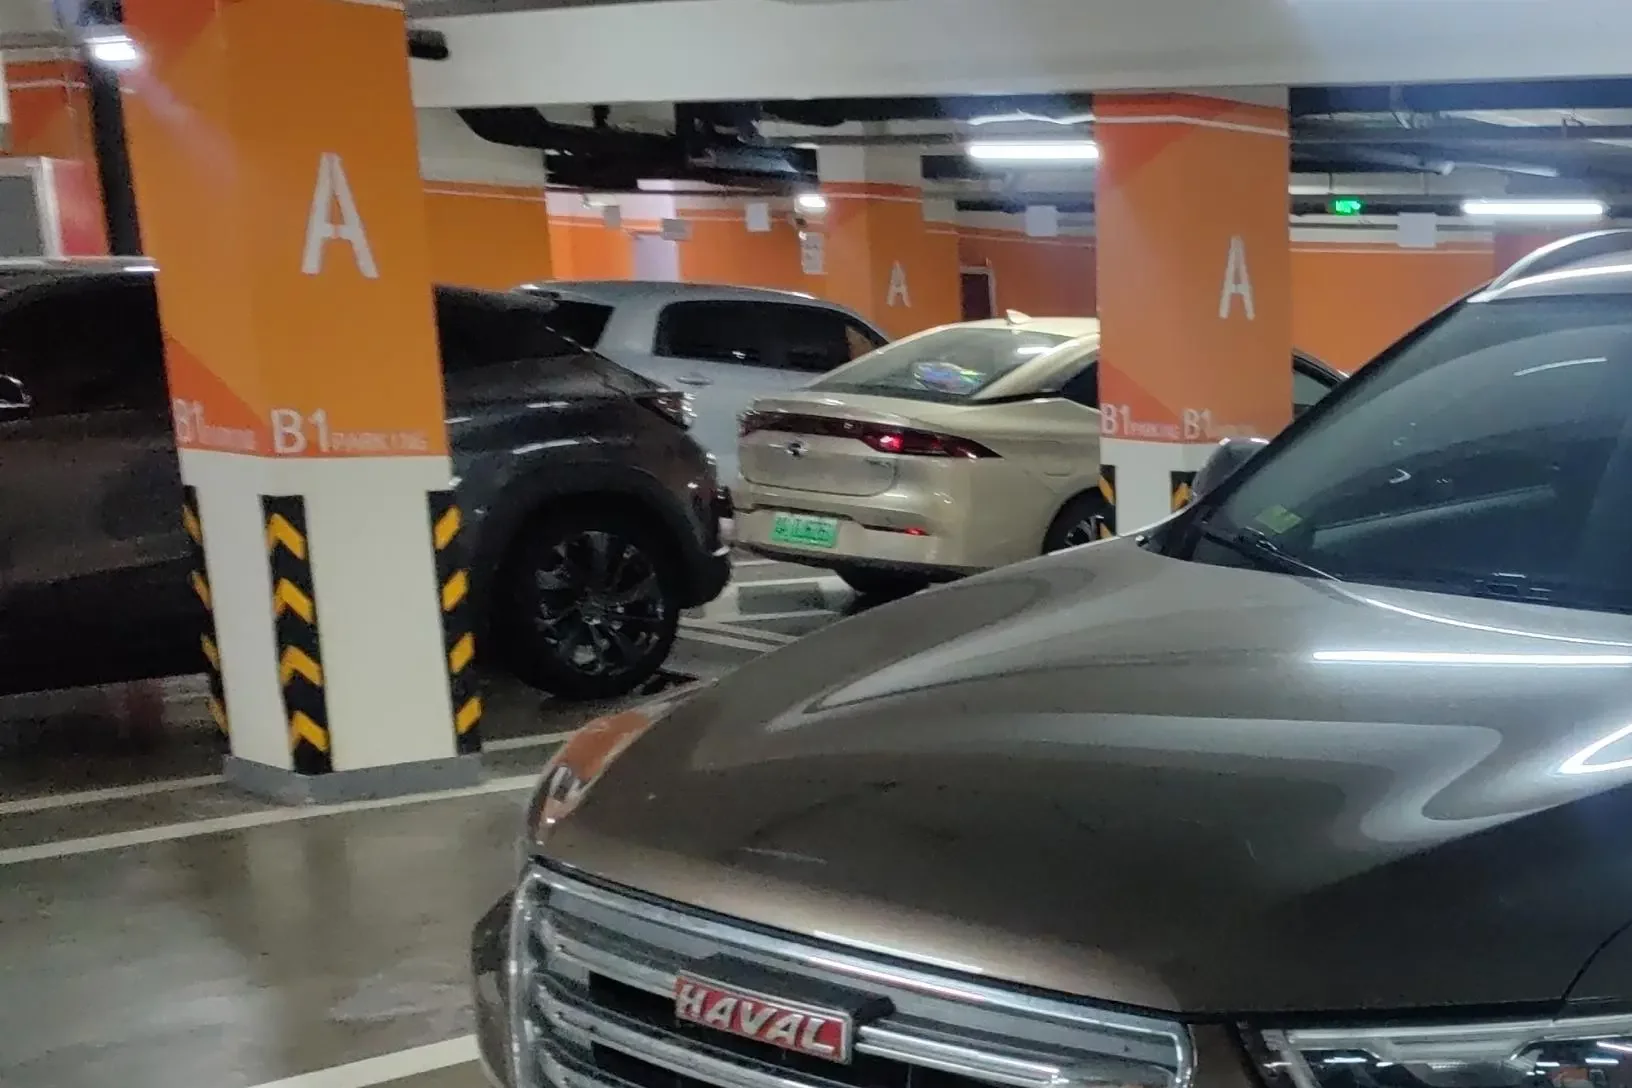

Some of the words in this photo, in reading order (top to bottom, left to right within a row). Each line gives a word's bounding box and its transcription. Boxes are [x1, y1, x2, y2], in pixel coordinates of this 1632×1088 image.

[301, 151, 380, 280] A
[885, 259, 913, 308] A
[1219, 235, 1256, 320] A
[172, 399, 205, 444] B1
[271, 408, 330, 454] B1
[1100, 402, 1131, 436] B1
[1183, 407, 1213, 440] B1
[675, 983, 835, 1053] HAVAL
